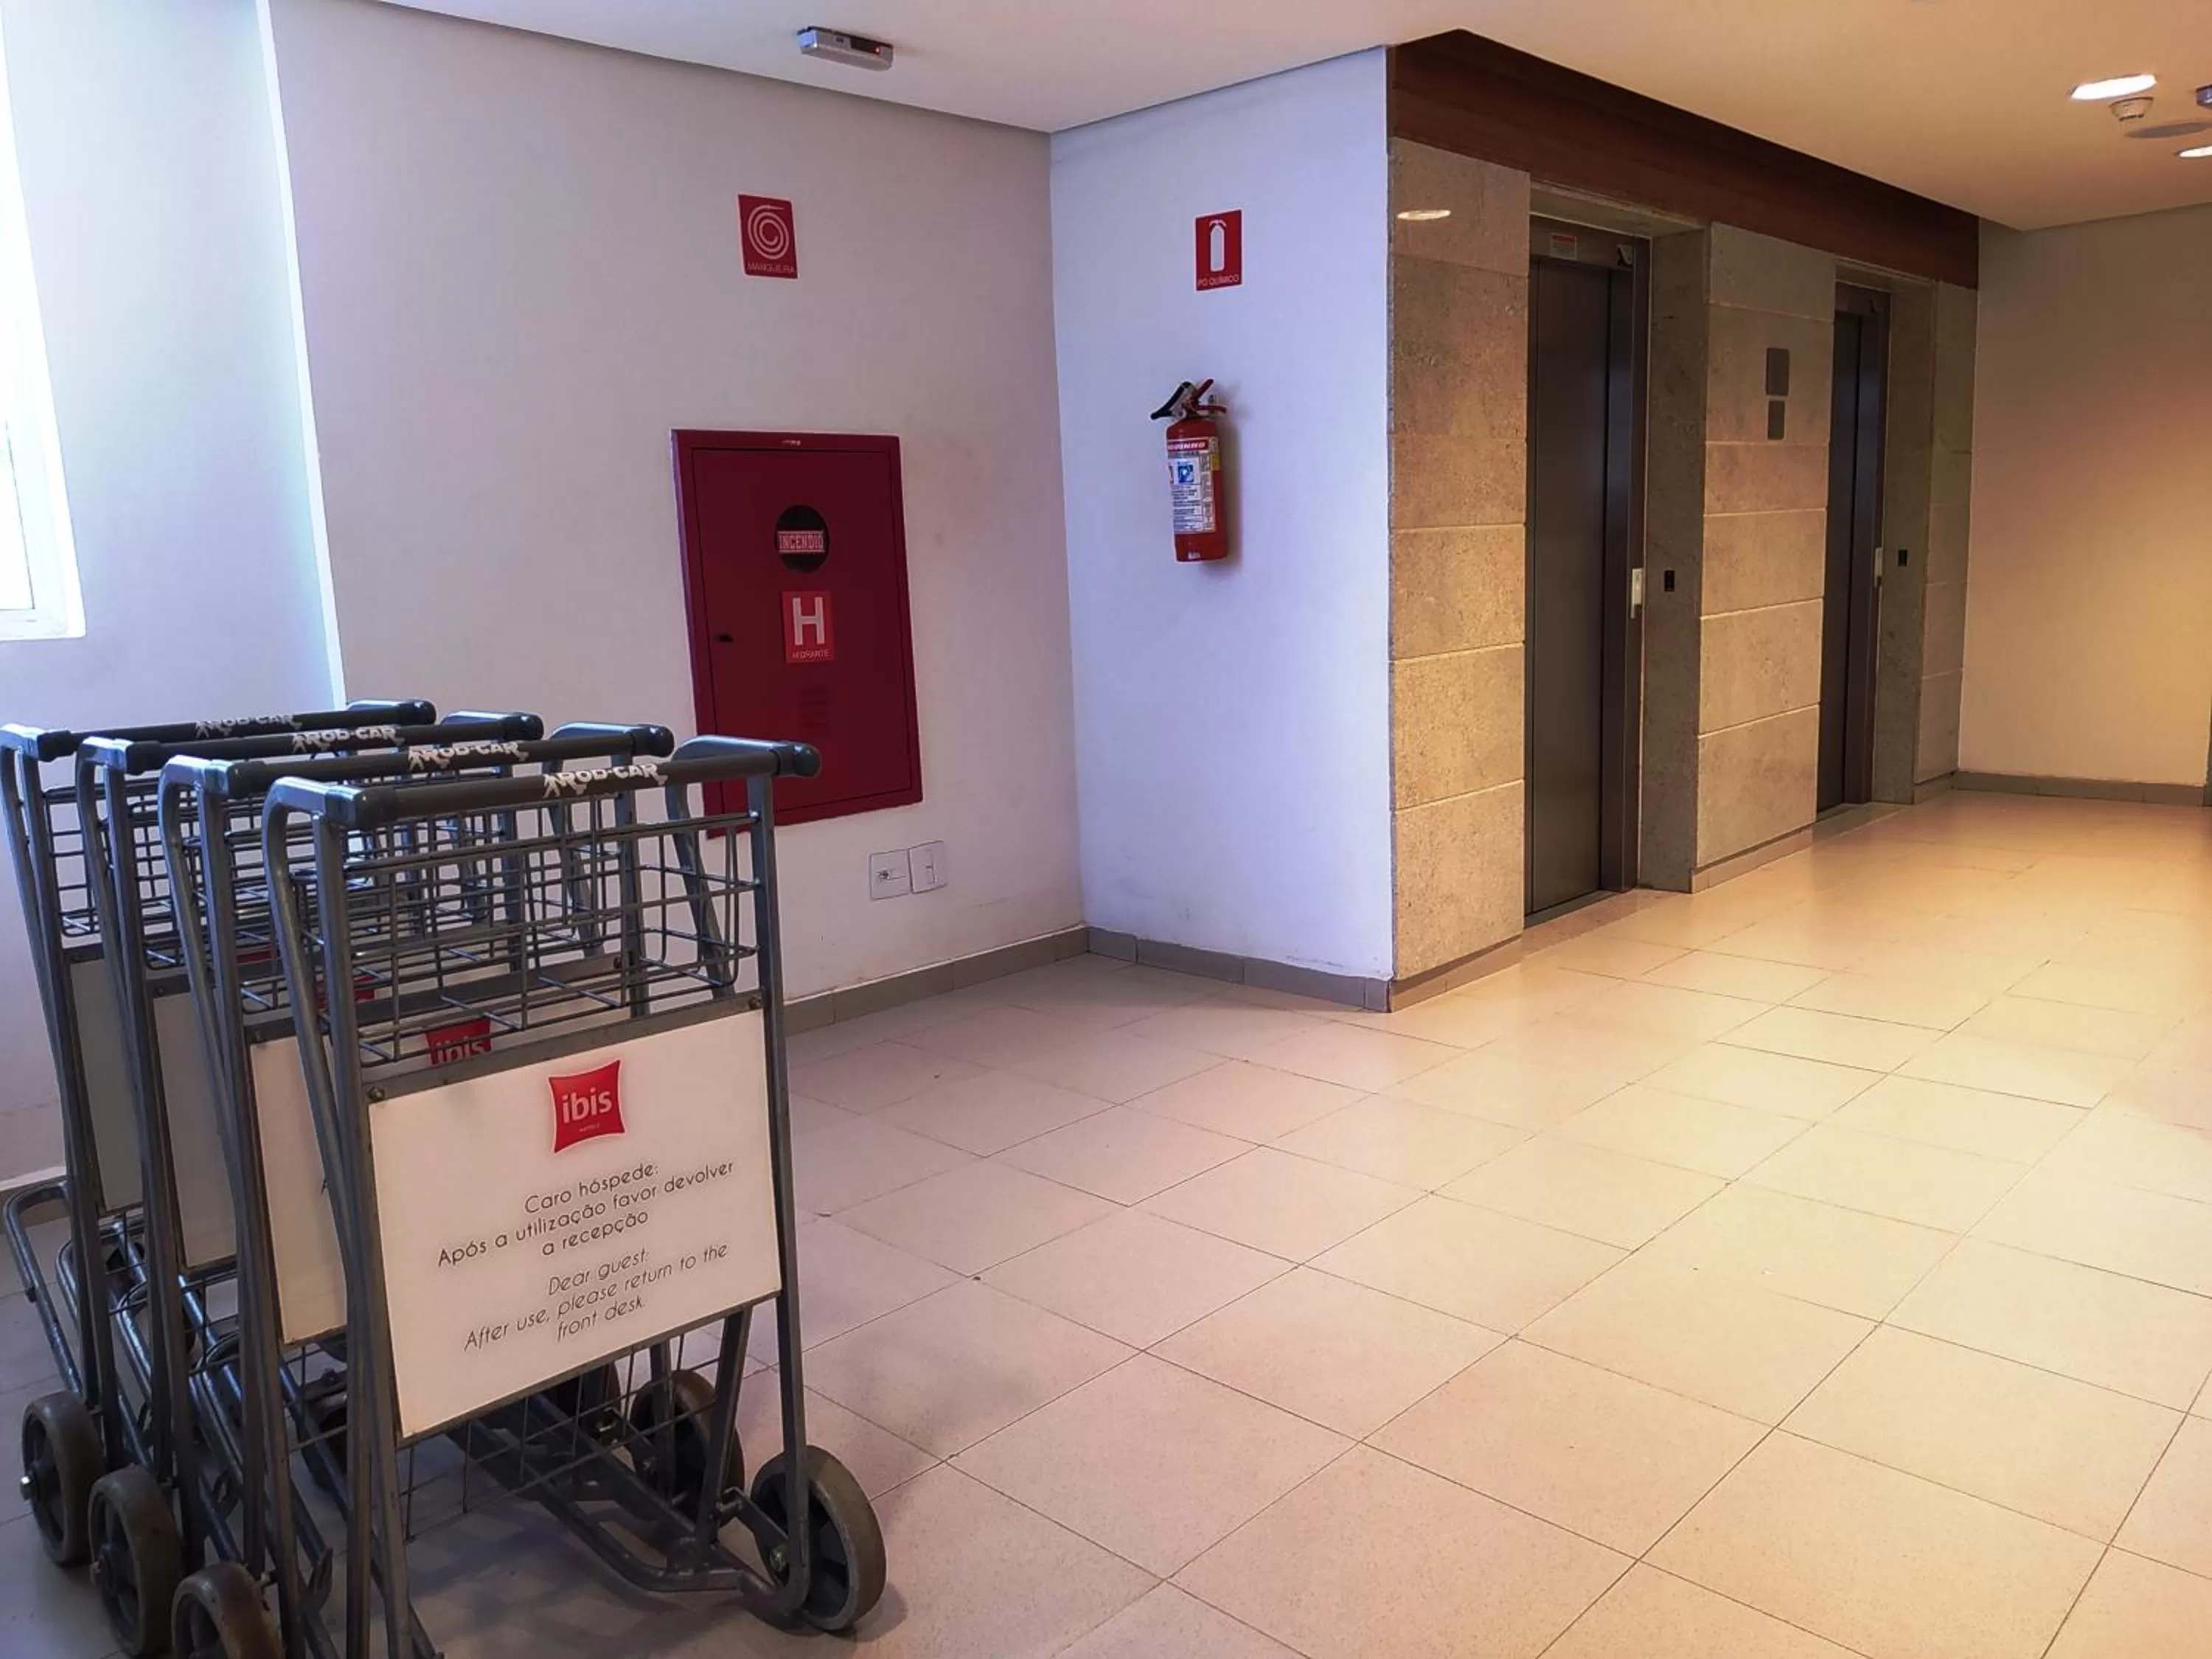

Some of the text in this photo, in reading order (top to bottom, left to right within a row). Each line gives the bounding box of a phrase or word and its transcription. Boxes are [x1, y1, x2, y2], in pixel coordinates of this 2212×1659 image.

[792, 597, 825, 646] H
[562, 1086, 613, 1124] ibis
[438, 1161, 734, 1267] Após a utilização favor devolver
[524, 1190, 572, 1214] Caro
[542, 1211, 648, 1256] a recepção
[549, 1247, 650, 1295] Dear guest:
[464, 1323, 509, 1352] After
[557, 1283, 617, 1321] please
[625, 1265, 672, 1290] return
[680, 1256, 697, 1270] to
[703, 1244, 728, 1263] the
[557, 1310, 597, 1343] front
